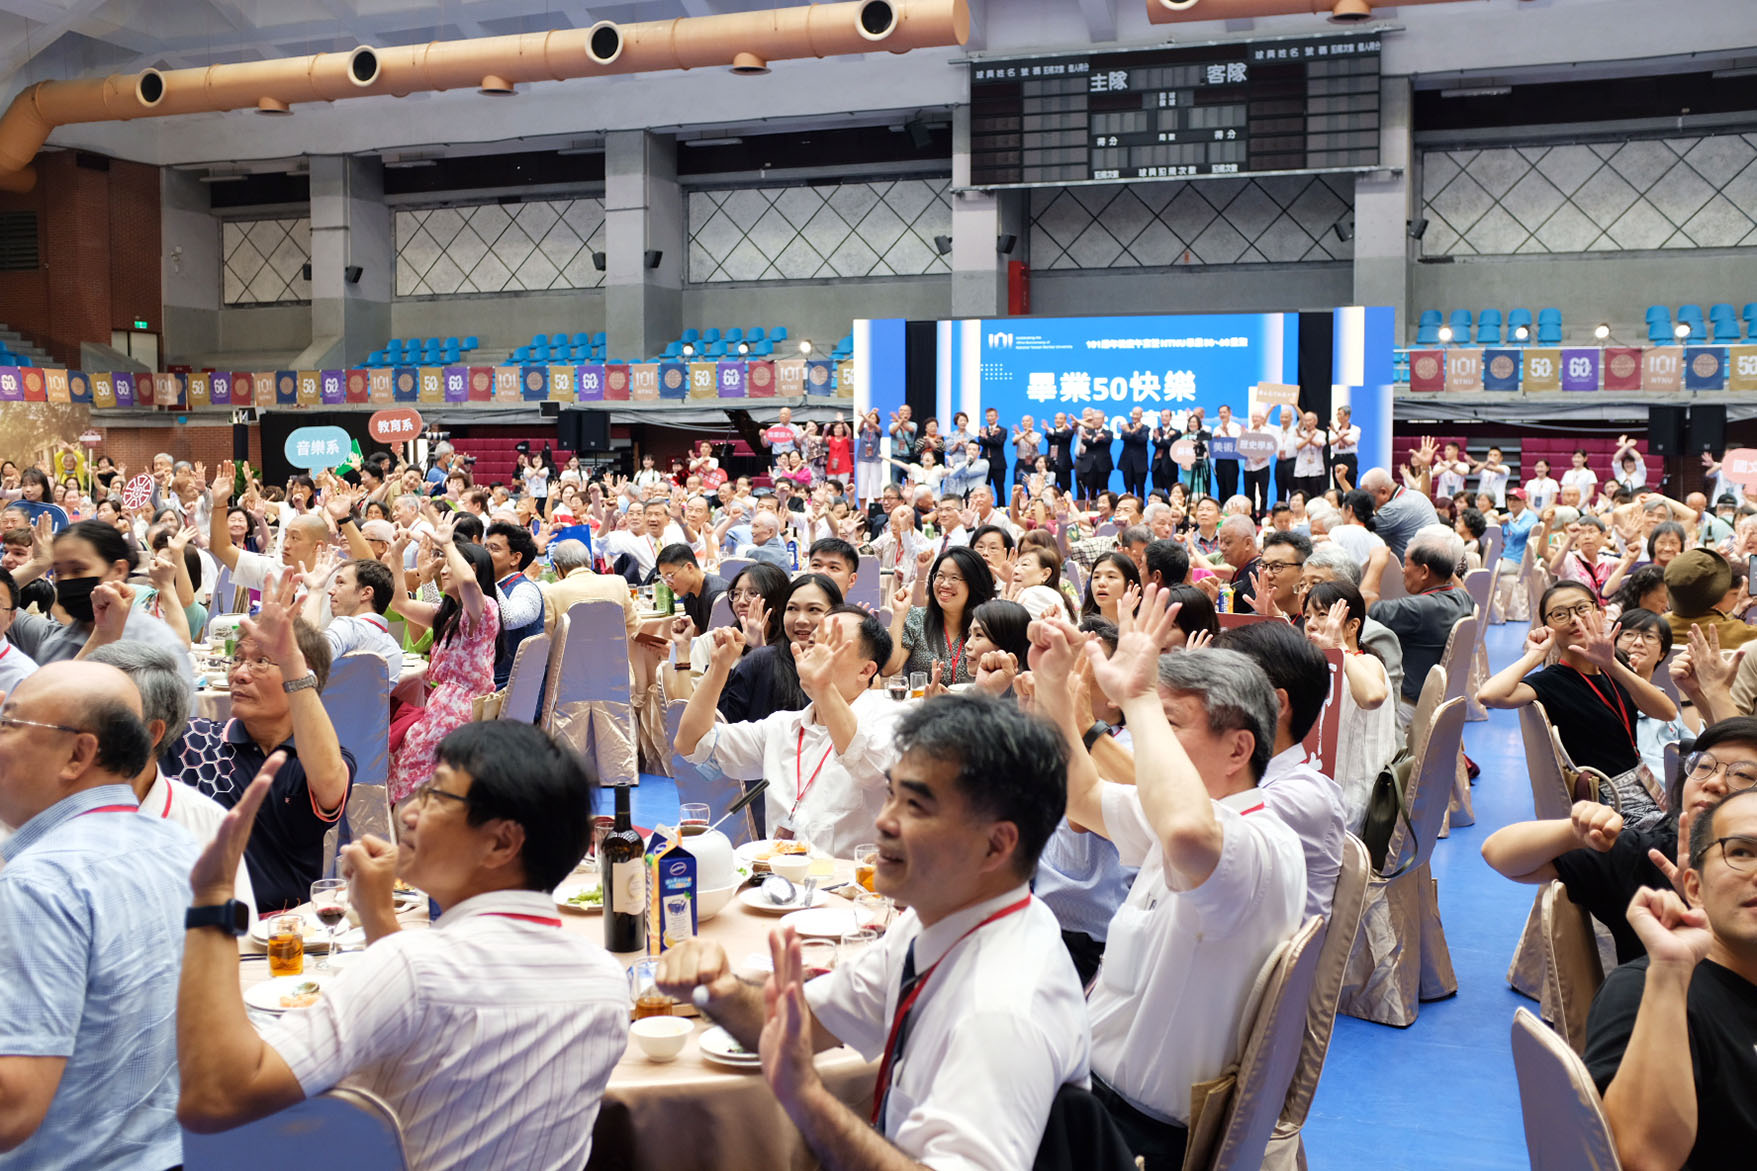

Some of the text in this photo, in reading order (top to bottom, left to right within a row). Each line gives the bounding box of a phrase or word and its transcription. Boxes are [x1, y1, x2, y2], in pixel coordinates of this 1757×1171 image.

[1207, 62, 1247, 84] 客隊
[1090, 70, 1128, 92] 主隊
[1097, 136, 1118, 147] 得分
[1214, 129, 1237, 140] 得分
[1451, 357, 1476, 376] 101
[1649, 355, 1676, 374] 101
[498, 373, 517, 388] 101
[636, 371, 654, 386] 101
[780, 367, 799, 381] 101
[373, 376, 389, 390] 101
[1027, 370, 1196, 403] 畢業50快樂
[377, 418, 413, 434] 教育系
[296, 439, 340, 456] 音樂系
[1213, 441, 1236, 453] 美術
